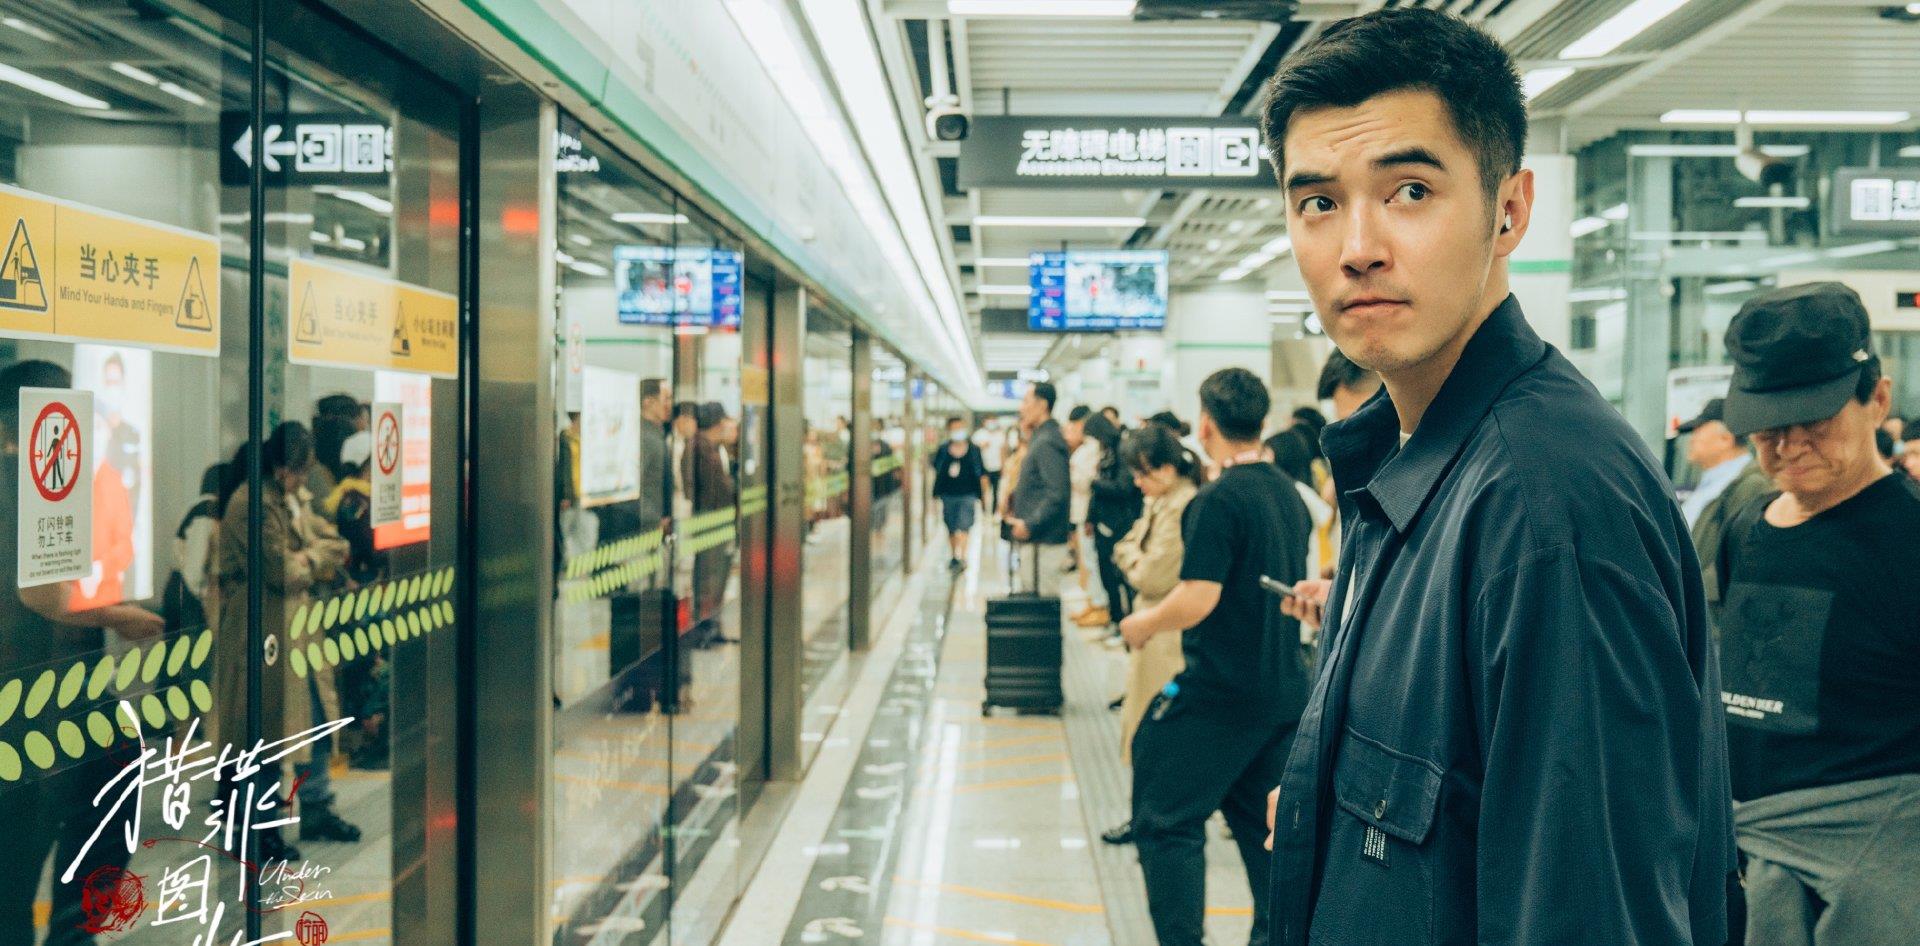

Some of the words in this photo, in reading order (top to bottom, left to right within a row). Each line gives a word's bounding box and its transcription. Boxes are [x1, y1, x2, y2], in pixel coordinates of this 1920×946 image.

[80, 244, 160, 291] 当心夹手
[59, 285, 81, 301] Mind
[83, 287, 102, 304] Your
[104, 294, 129, 309] Hands
[131, 298, 145, 310] and
[147, 299, 174, 317] Fingers
[38, 514, 74, 533] 灯闪铃响
[38, 531, 74, 548] 勿上下车
